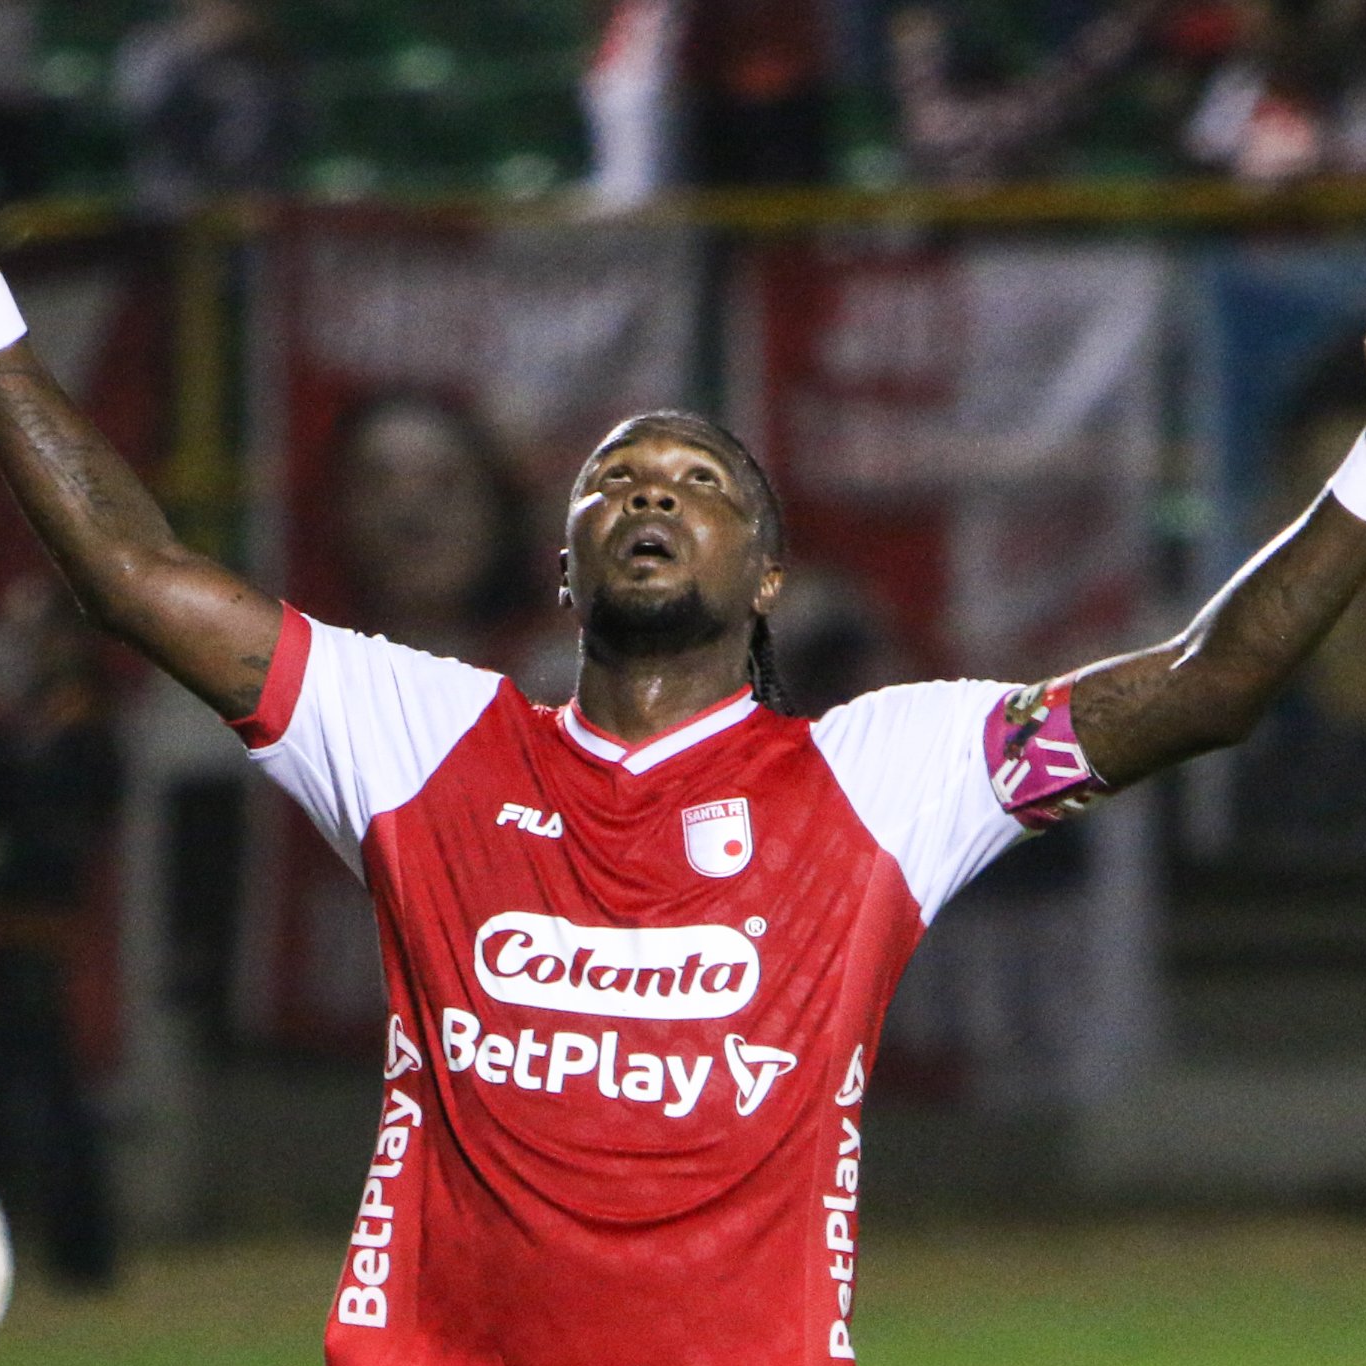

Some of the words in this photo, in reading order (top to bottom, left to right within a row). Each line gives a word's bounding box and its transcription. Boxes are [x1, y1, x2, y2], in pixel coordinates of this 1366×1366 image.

[496, 803, 564, 839] FILA
[685, 804, 726, 824] SANTA
[727, 802, 744, 816] FE
[482, 928, 748, 998] Colanta
[442, 1007, 714, 1118] BetPlay
[338, 1088, 422, 1328] BetPlay
